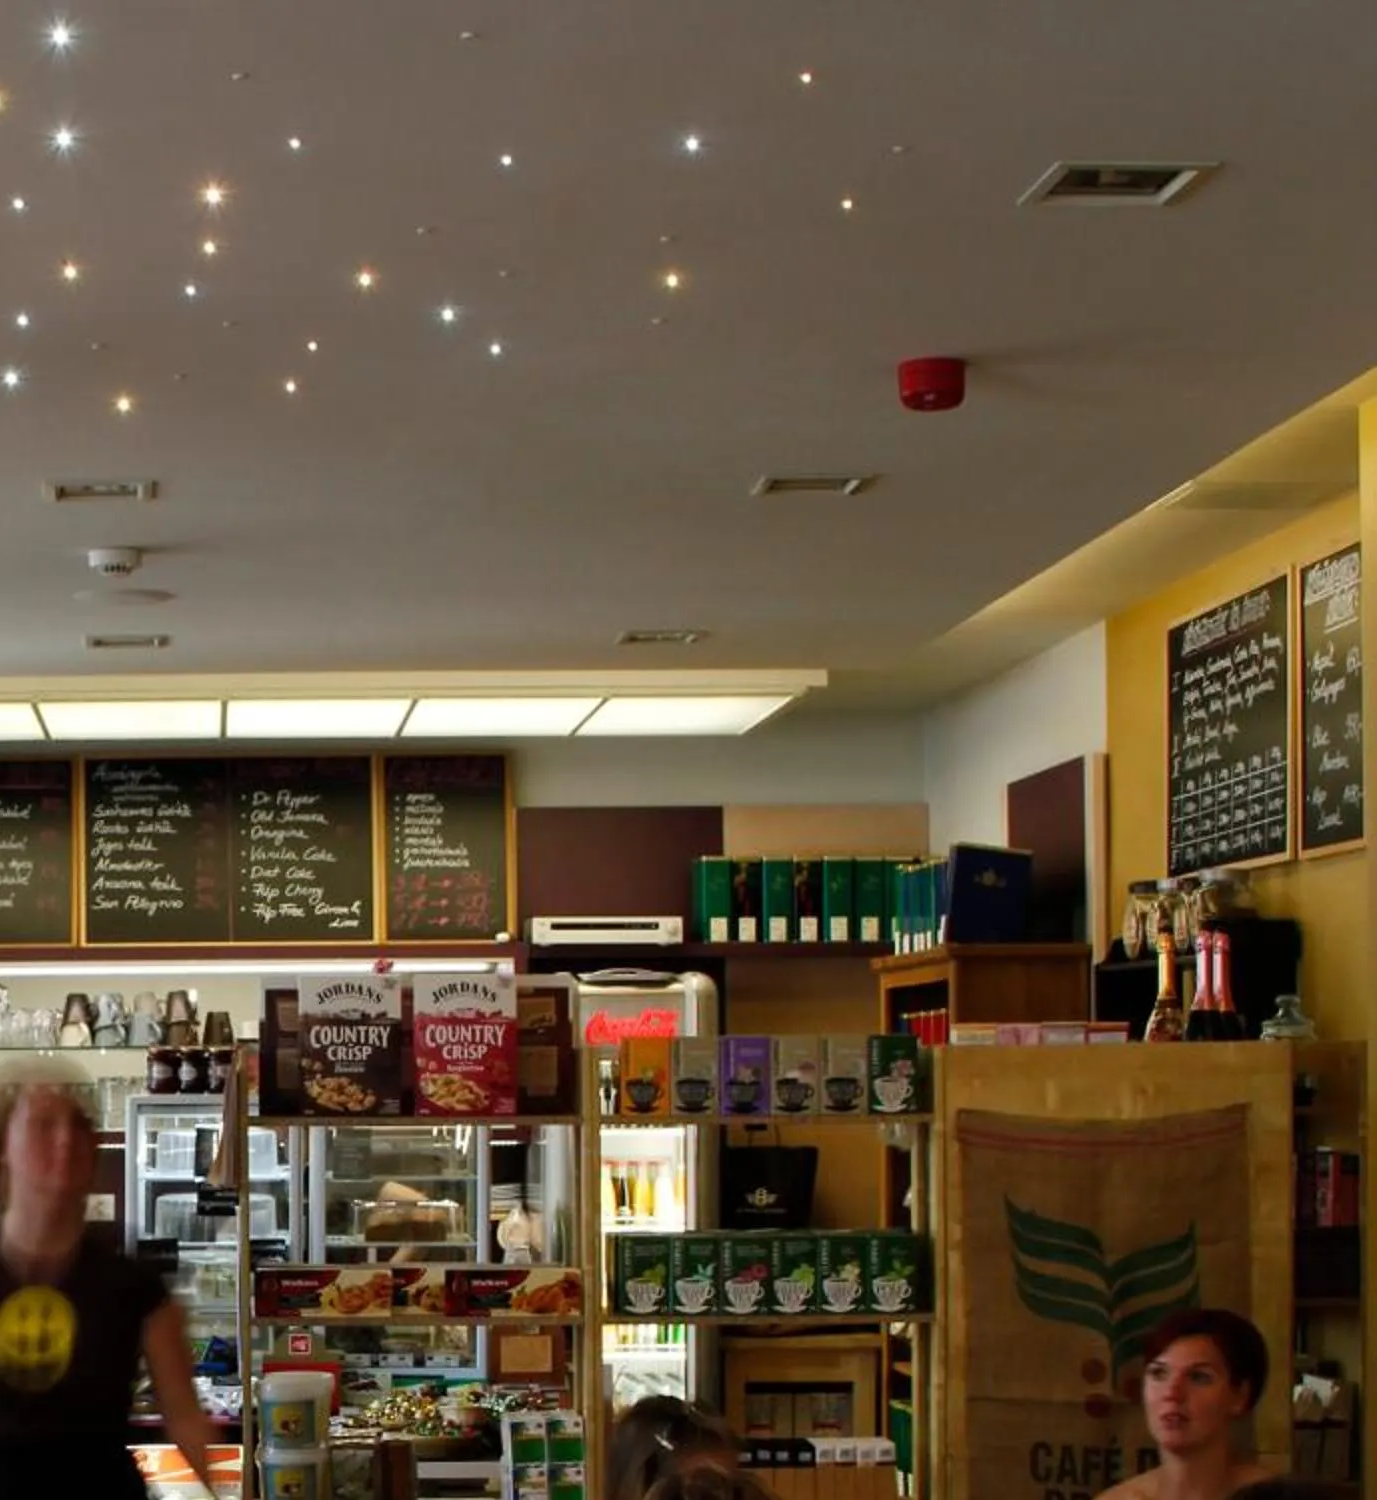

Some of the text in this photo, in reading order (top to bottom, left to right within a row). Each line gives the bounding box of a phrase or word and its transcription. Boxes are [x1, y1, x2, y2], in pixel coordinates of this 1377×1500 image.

[317, 982, 383, 1005] JORDANS
[431, 981, 497, 1004] JORDANS
[310, 1025, 391, 1050] COUNTRY
[425, 1024, 506, 1048] COUNTRY
[1030, 1435, 1122, 1487] CAFÉ
